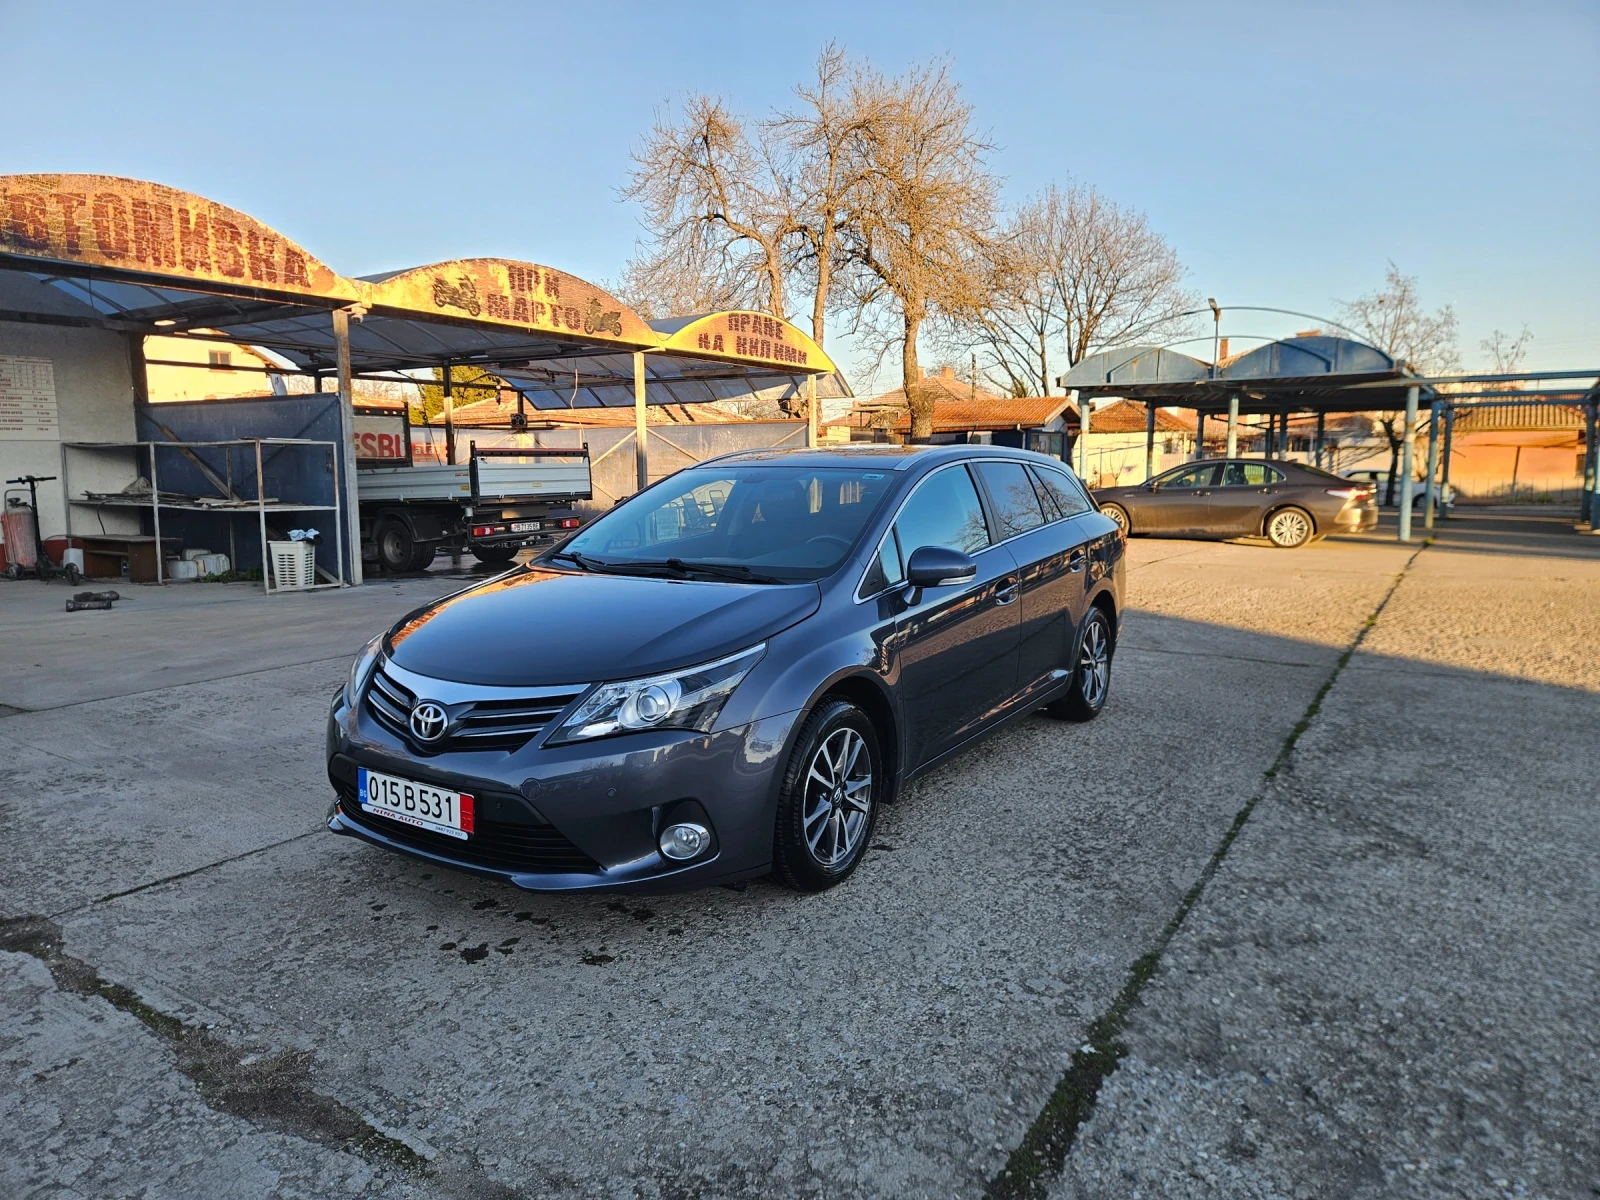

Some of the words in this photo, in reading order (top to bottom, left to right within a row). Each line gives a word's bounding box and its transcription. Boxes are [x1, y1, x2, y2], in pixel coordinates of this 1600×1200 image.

[728, 312, 783, 340] ПРАНЕ
[698, 333, 725, 352] НА
[736, 335, 807, 365] КИЛИМИ
[359, 787, 367, 799] BG
[373, 807, 396, 819] NINA
[399, 814, 424, 827] AUTO
